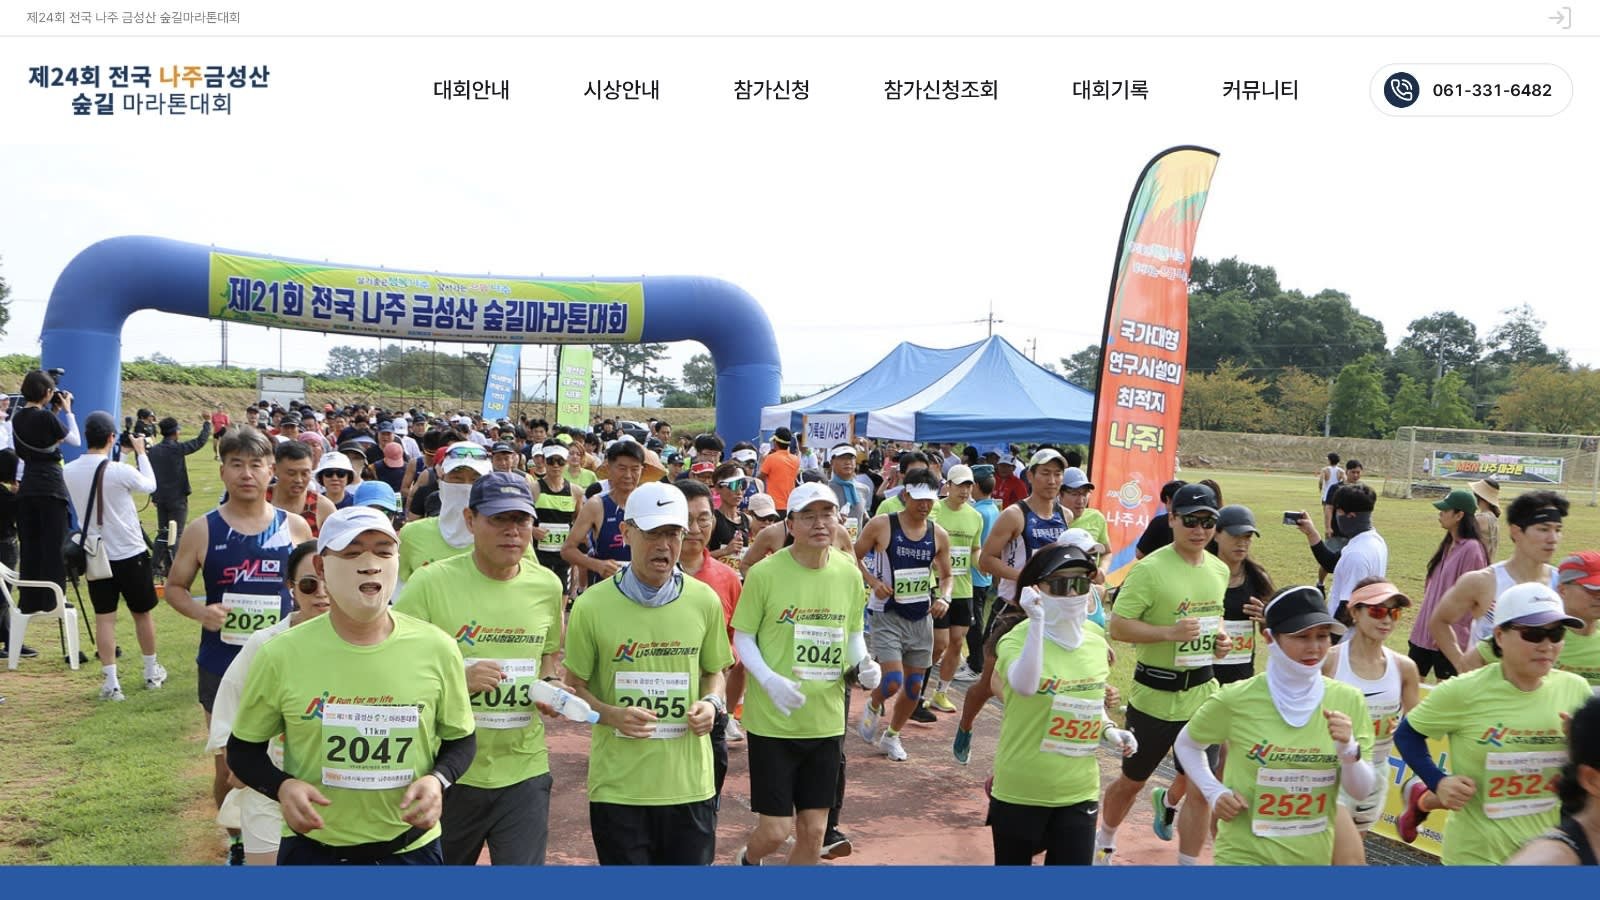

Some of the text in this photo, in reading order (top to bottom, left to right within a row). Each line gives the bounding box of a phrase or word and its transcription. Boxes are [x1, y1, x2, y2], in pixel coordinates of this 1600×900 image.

[228, 277, 628, 334] 제21회 전국 나주 금성산 숲길마라톤대회
[1120, 319, 1180, 352] 국가대형
[1109, 351, 1182, 385] 연구시설의
[1117, 386, 1165, 413] 최적지
[1108, 421, 1164, 453] 나주!
[1106, 511, 1150, 530] 나주시
[896, 580, 928, 594] 2172
[797, 645, 842, 665] 2042
[335, 697, 352, 705] Run
[353, 696, 366, 704] for
[364, 727, 387, 736] 11km
[1048, 716, 1101, 740] 2522
[326, 735, 413, 764] 2047
[1257, 793, 1327, 817] 2521
